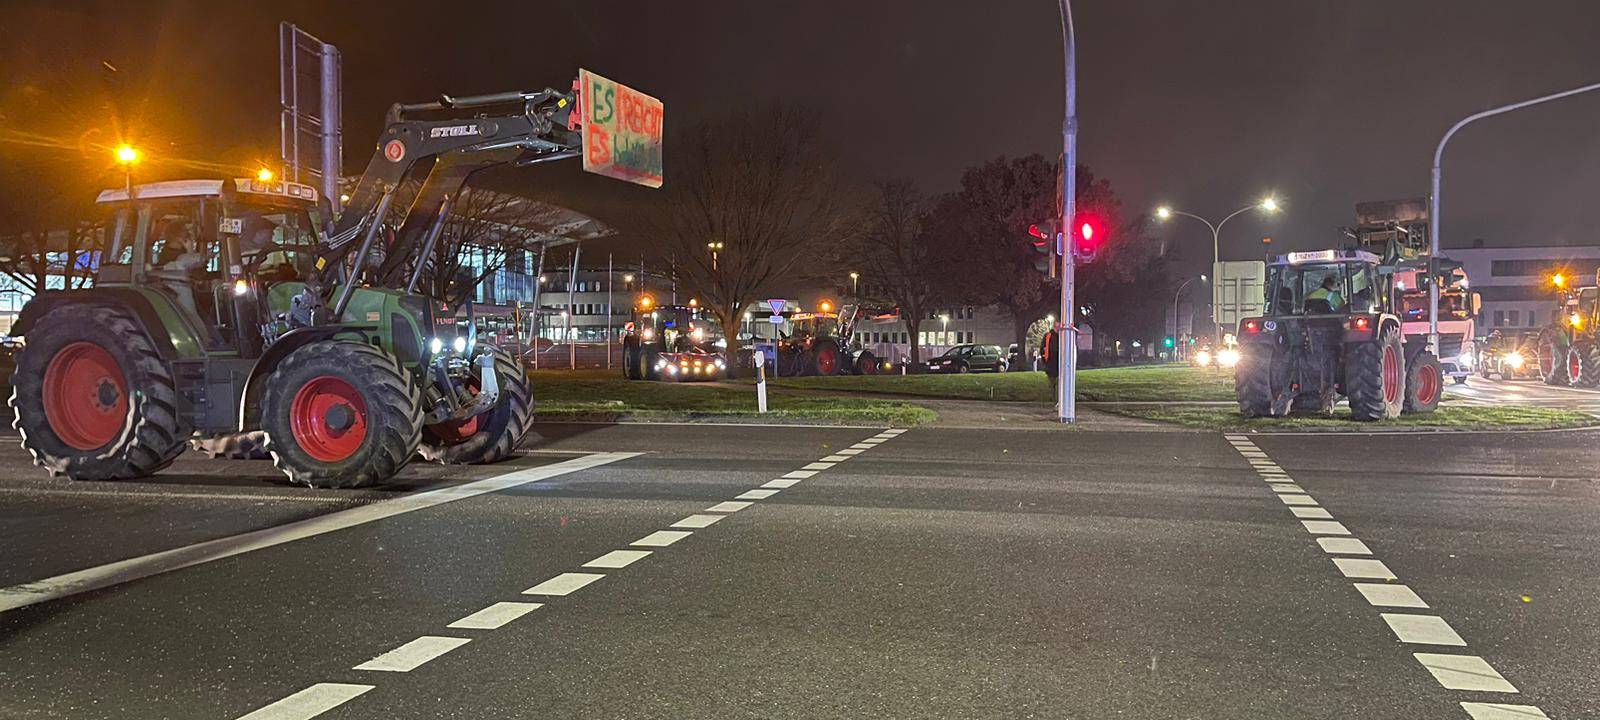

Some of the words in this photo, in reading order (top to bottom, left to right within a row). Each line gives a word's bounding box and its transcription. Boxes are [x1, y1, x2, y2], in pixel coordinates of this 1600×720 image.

[593, 81, 614, 124] ES
[430, 124, 478, 138] STOLL
[589, 122, 610, 165] ES
